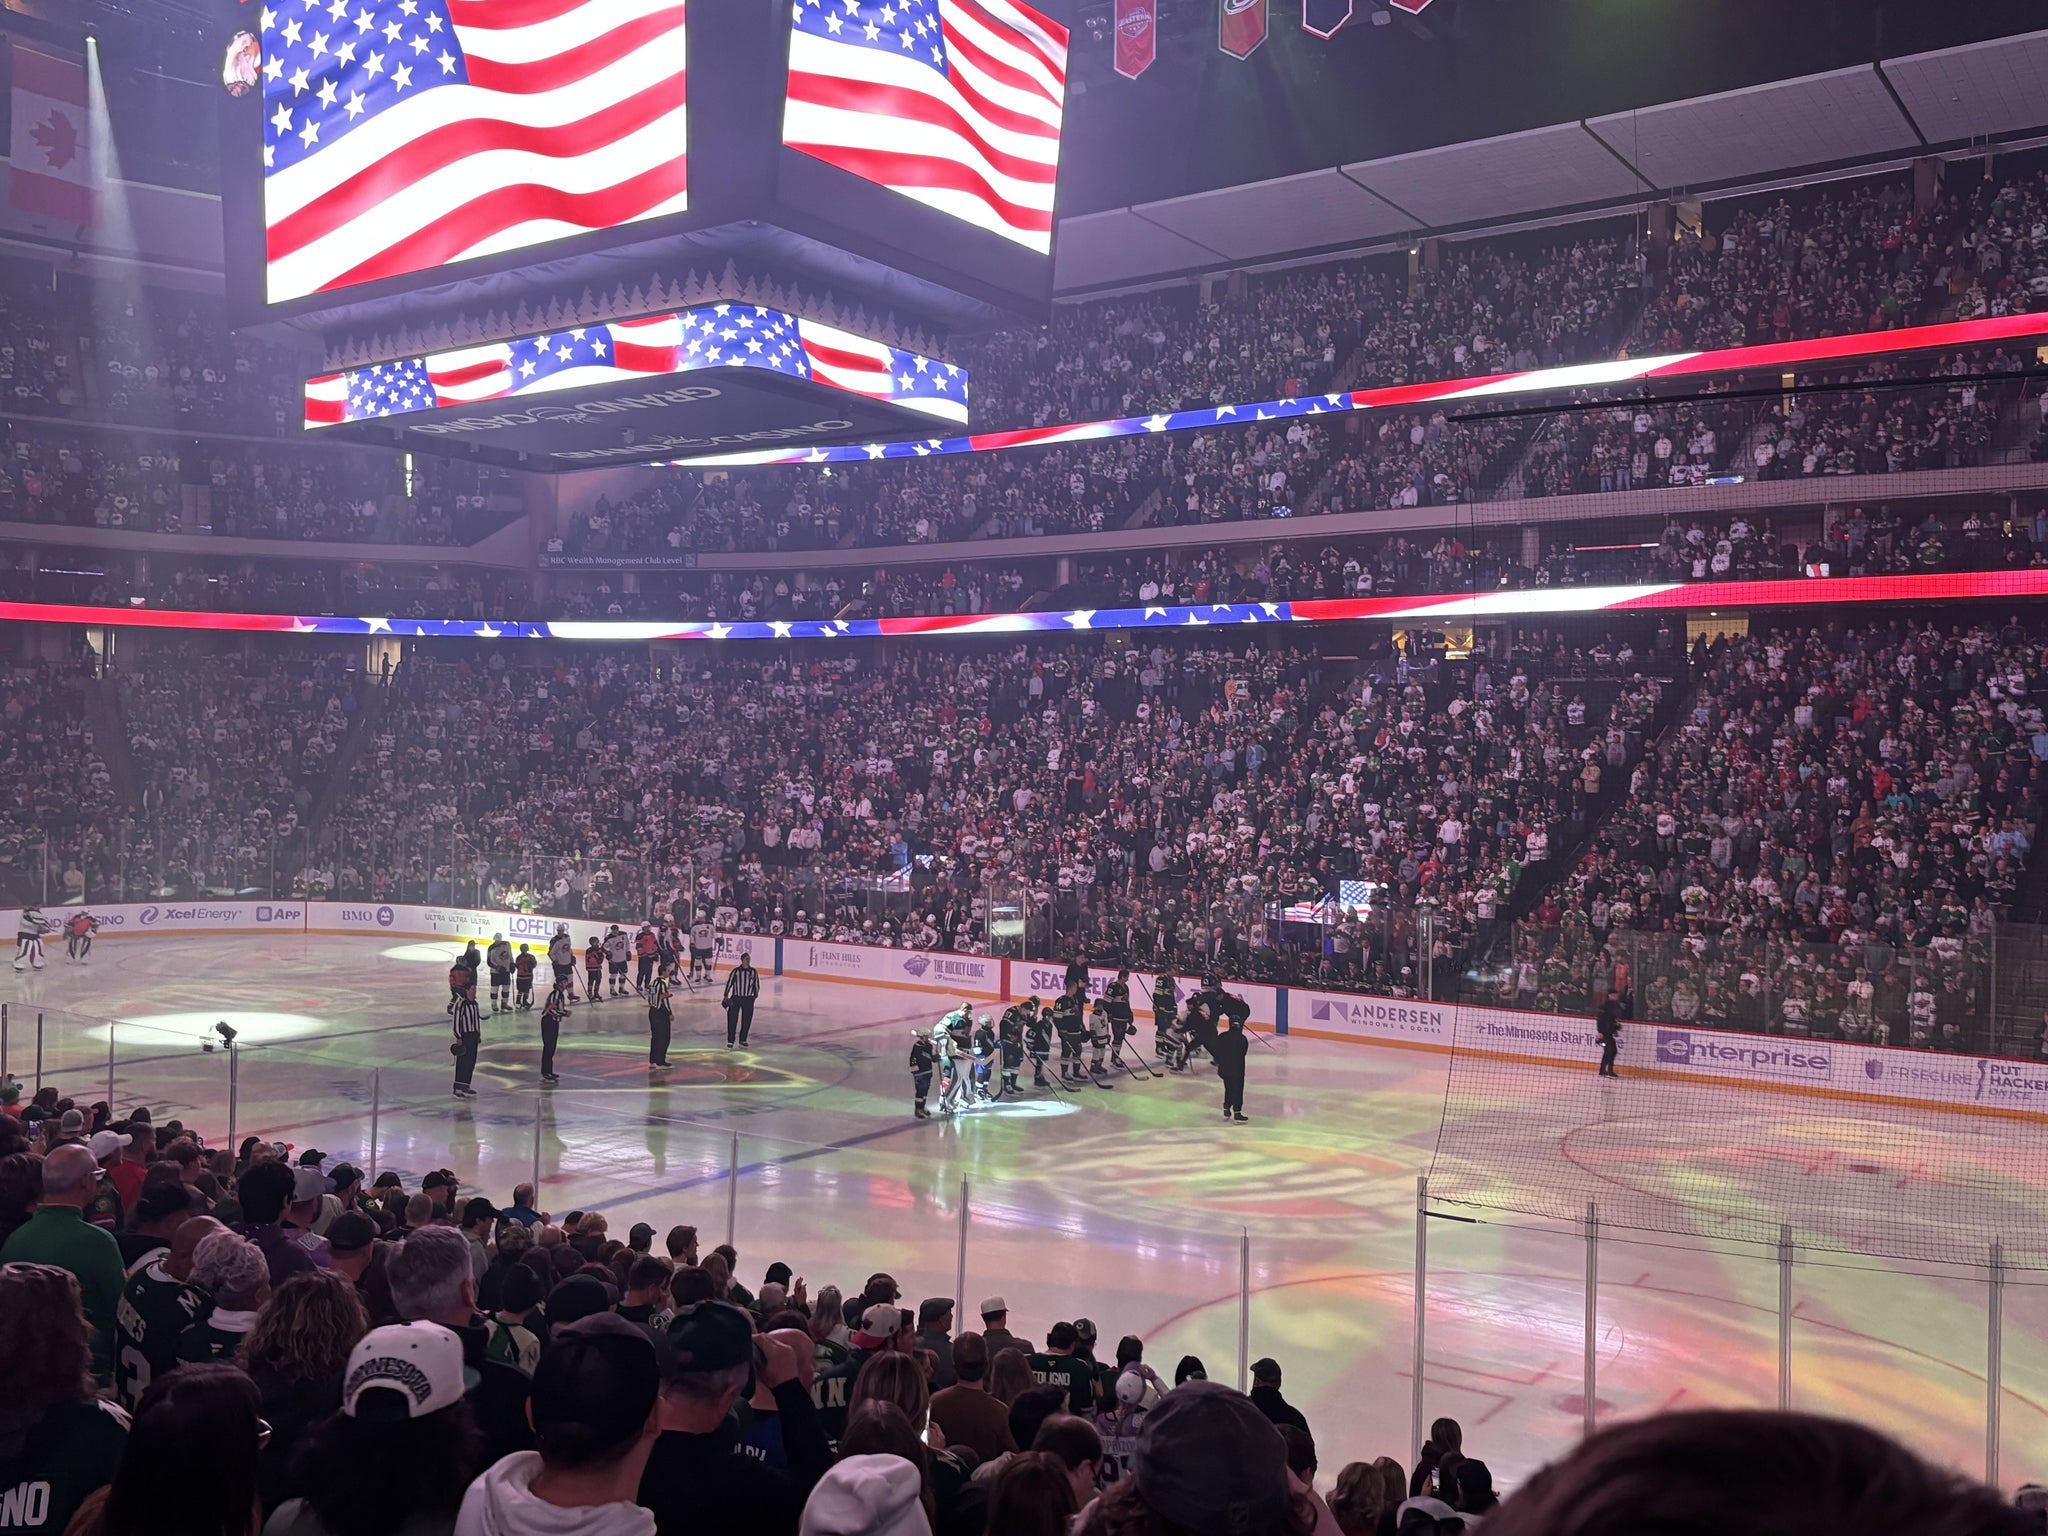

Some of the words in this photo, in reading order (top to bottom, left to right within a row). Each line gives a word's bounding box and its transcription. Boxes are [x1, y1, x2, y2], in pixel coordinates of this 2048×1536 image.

[575, 386, 722, 414] GRAND
[409, 414, 538, 433] CASINO
[711, 420, 853, 443] CASINO
[567, 556, 594, 564] Wealth
[595, 556, 643, 567] Management
[645, 556, 661, 564] Club
[662, 556, 682, 564] Level
[274, 908, 301, 920] App
[342, 910, 373, 921] BMO
[424, 913, 445, 921] ULTRA
[841, 953, 861, 963] HILLS
[934, 959, 944, 974] THE
[1351, 1004, 1441, 1026] ANDERSEN
[1351, 1019, 1394, 1029] WINDOWS
[1410, 1025, 1441, 1034] DOORS
[1487, 1023, 1505, 1036] The
[1505, 1025, 1559, 1042] Minnesota
[1666, 1037, 1828, 1070] enterprise
[1890, 1066, 1973, 1086] FRSECURE
[1990, 1064, 2020, 1076] PUT
